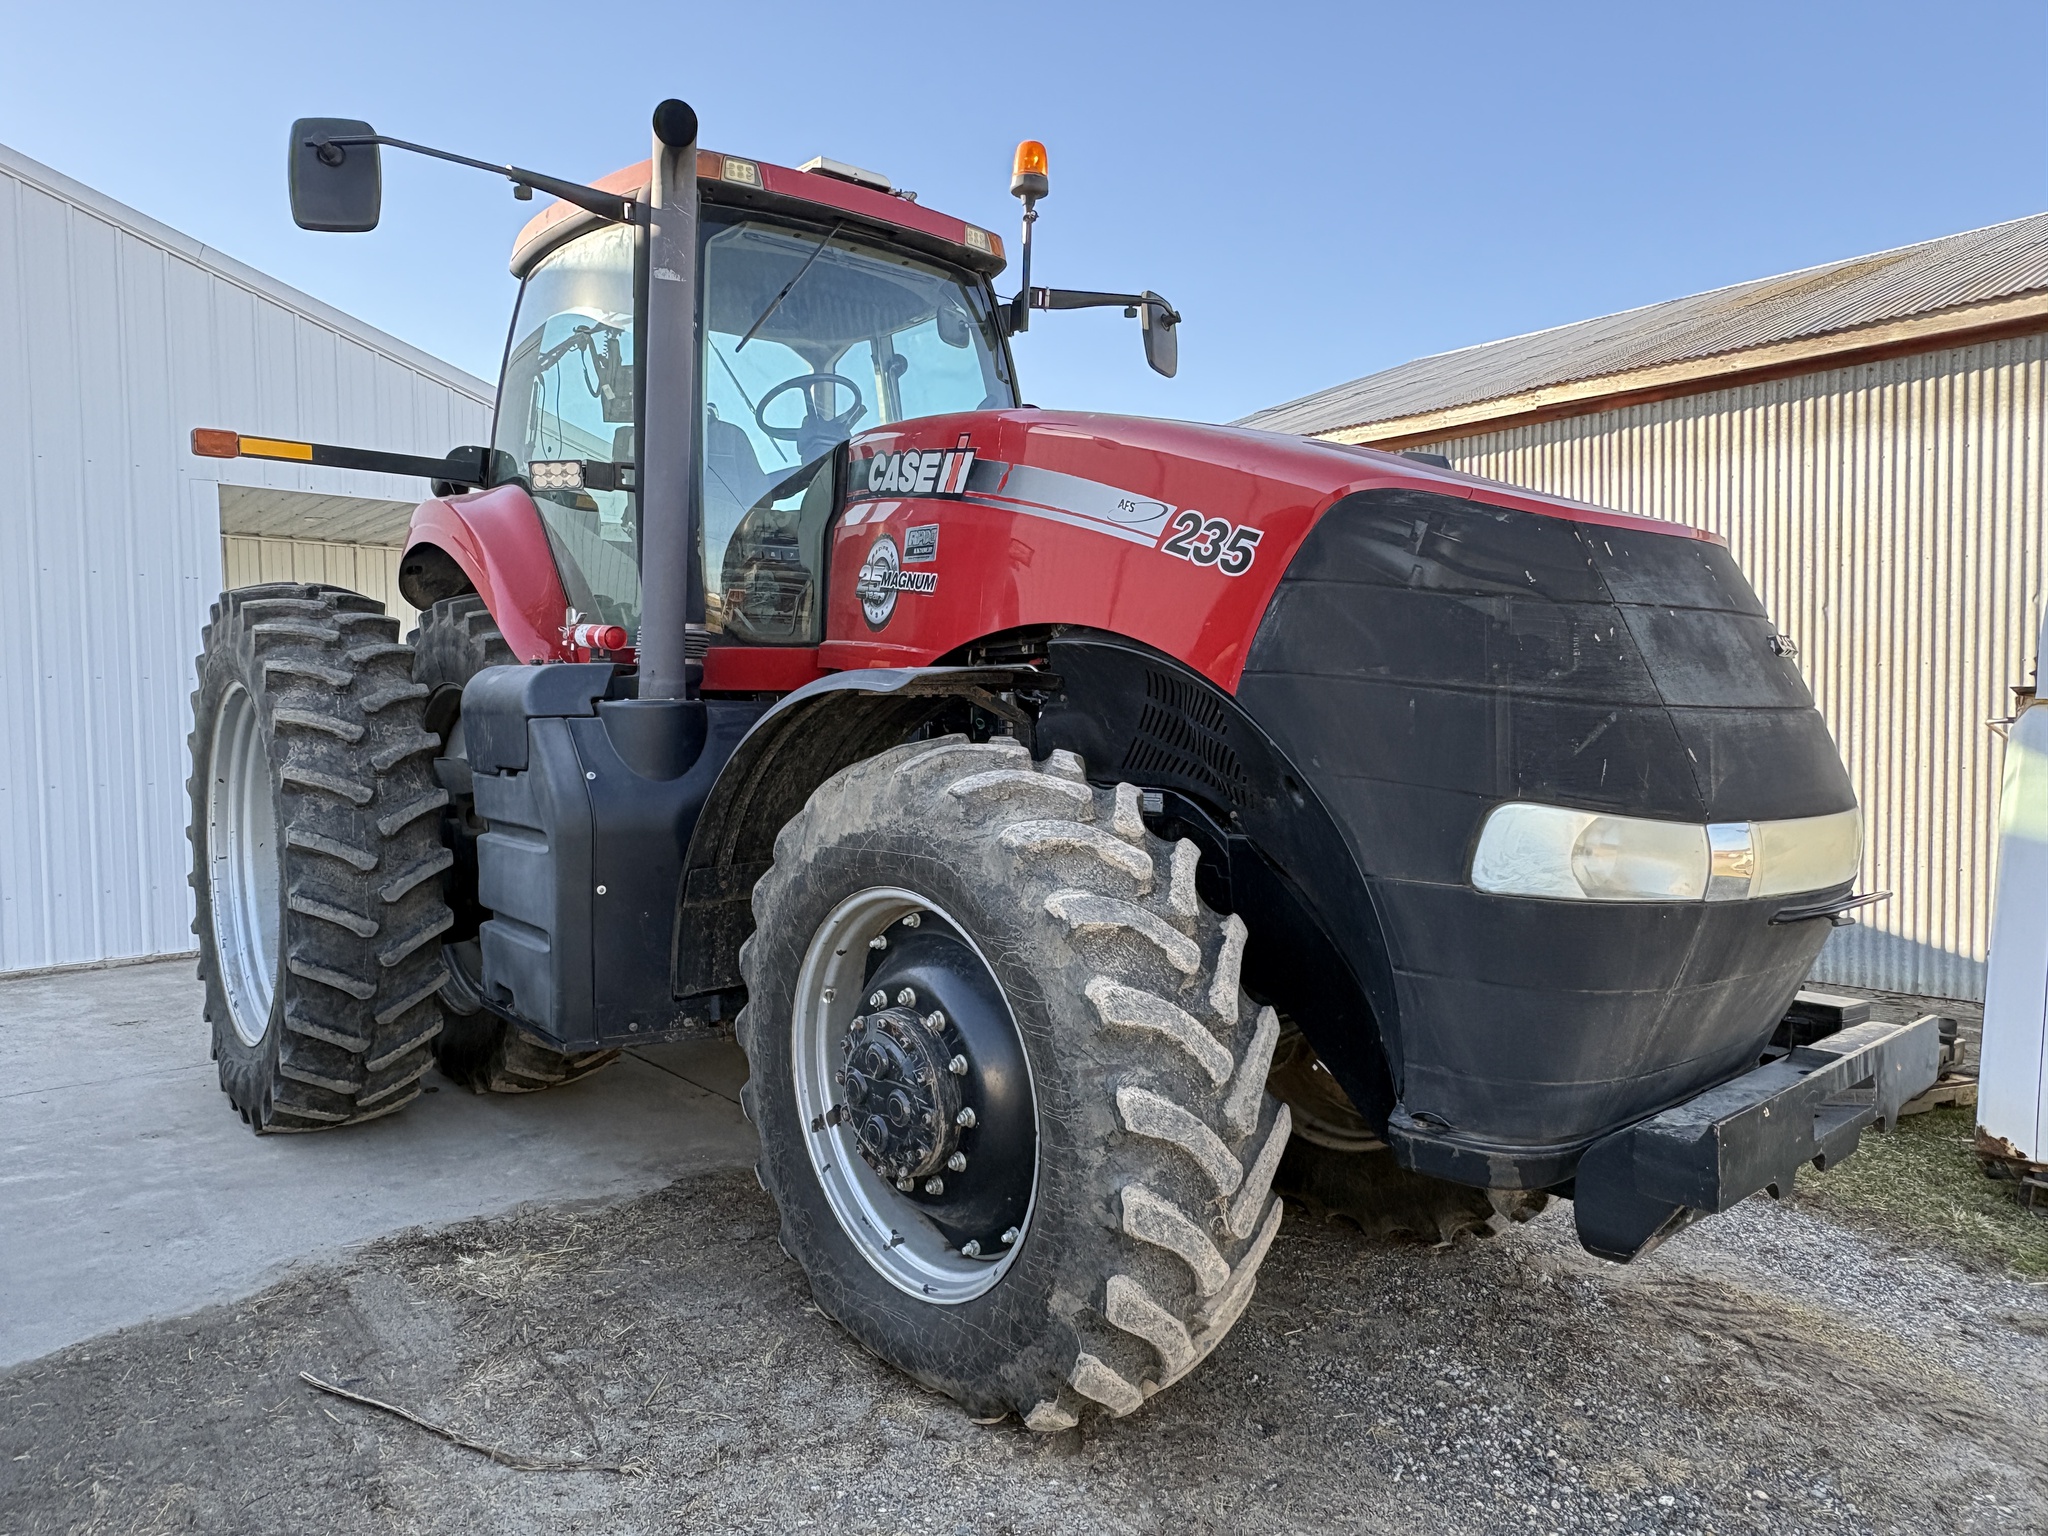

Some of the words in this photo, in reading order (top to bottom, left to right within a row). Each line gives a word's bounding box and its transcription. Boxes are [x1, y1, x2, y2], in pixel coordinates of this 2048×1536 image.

[868, 452, 941, 493] CASE
[1117, 498, 1136, 513] AFS
[1162, 511, 1263, 576] 235
[857, 565, 884, 593] 25
[881, 571, 937, 592] MAGNUM
[865, 591, 885, 603] years
